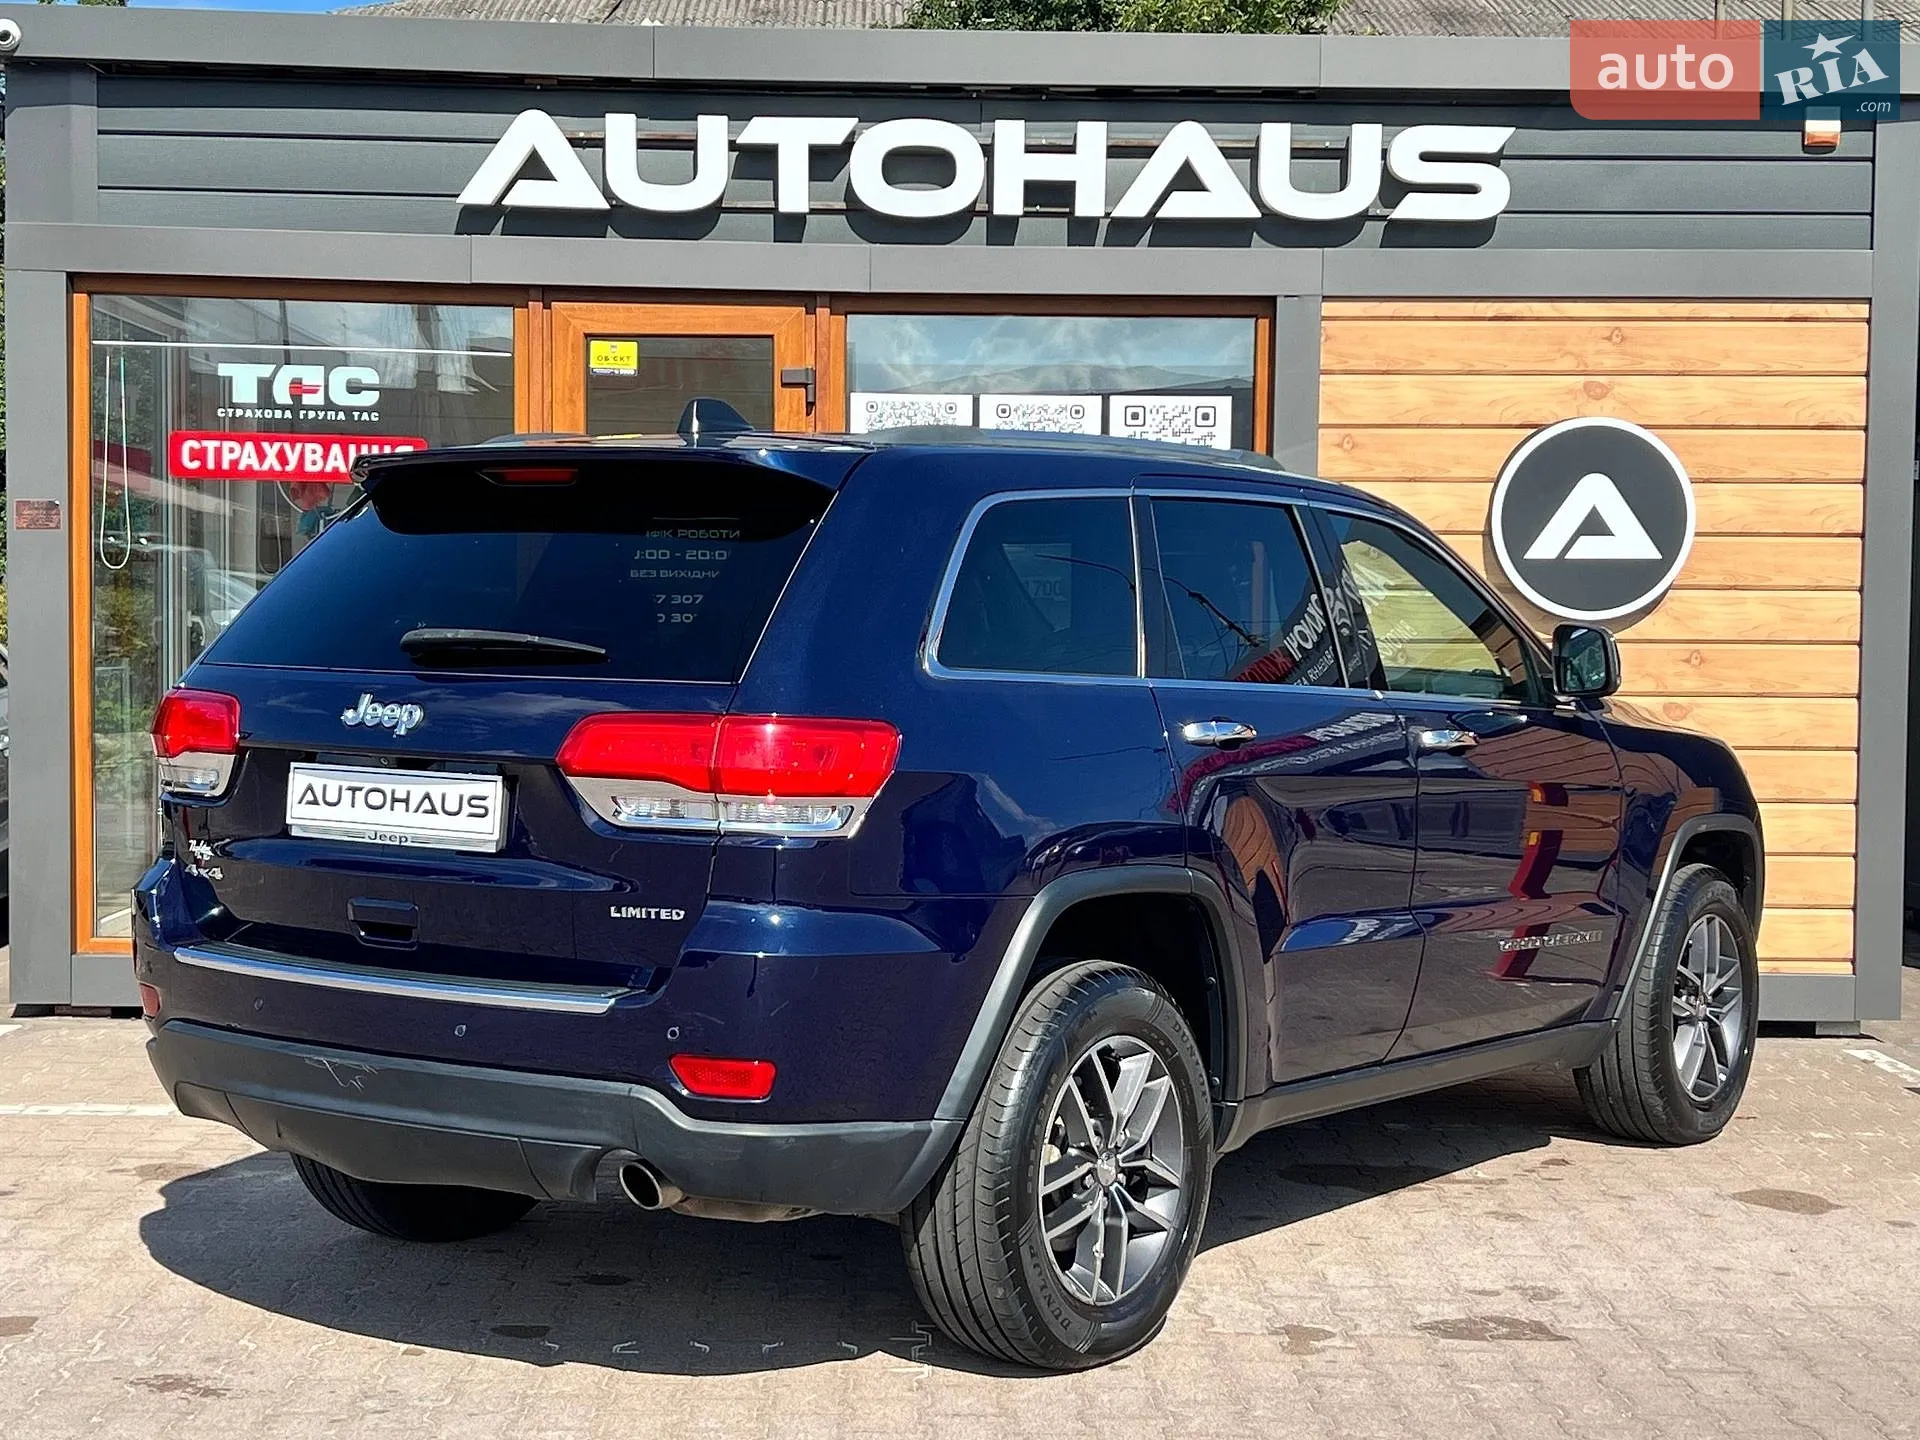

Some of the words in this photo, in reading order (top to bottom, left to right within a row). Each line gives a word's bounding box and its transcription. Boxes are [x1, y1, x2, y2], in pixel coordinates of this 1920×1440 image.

[456, 109, 1517, 222] AUTOHAUS
[217, 407, 292, 420] СТРАХОВА
[299, 409, 347, 422] ГРУПА
[352, 410, 380, 422] ТАС
[677, 529, 741, 539] РОБОТИ
[685, 549, 732, 560] 20:0
[629, 569, 657, 578] БЕЗ
[670, 594, 704, 604] 307
[341, 693, 424, 737] Jeep
[297, 782, 490, 819] AUTOHAUS
[368, 830, 409, 844] Jeep
[610, 905, 686, 921] LIMITED
